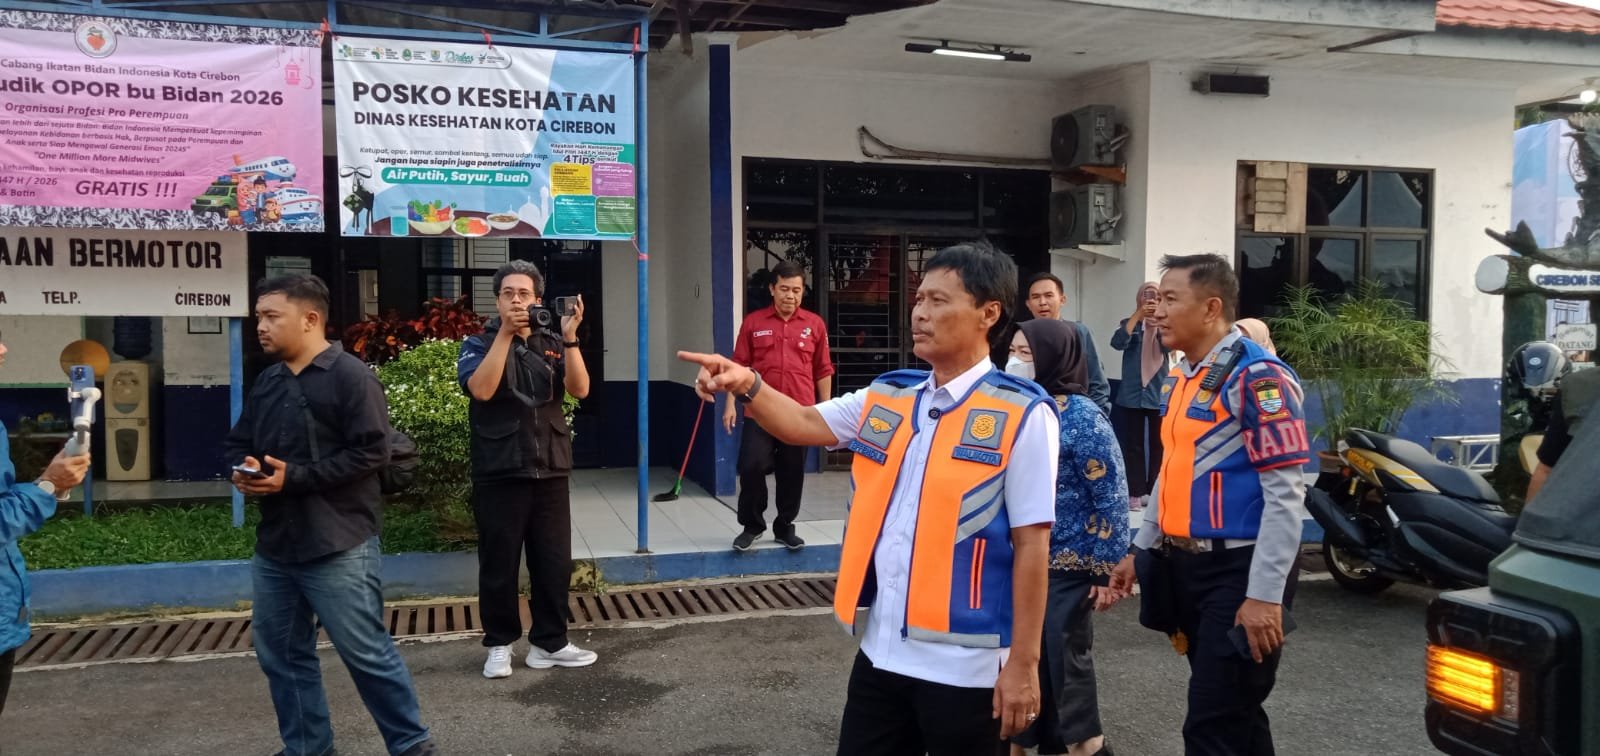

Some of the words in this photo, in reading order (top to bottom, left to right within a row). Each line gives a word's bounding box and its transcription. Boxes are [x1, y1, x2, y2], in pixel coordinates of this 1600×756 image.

[1, 59, 43, 72] Cabang
[46, 62, 81, 72] Ikatan
[85, 65, 115, 75] Bidan
[119, 66, 170, 77] Indonesia
[174, 70, 197, 80] Kota
[200, 71, 240, 81] Cirebon
[52, 80, 120, 98] OPOR
[128, 84, 155, 100] bu
[162, 86, 224, 103] Bidan
[230, 90, 284, 106] 2026
[353, 81, 451, 106] POSKO
[458, 88, 616, 114] KESEHATAN
[5, 102, 64, 114] Organisasi
[68, 106, 105, 117] Profesi
[108, 108, 126, 117] Pro
[130, 109, 189, 120] Perempuan
[163, 126, 209, 135] Memperkuat
[354, 112, 405, 127] DINAS
[408, 114, 502, 130] KESEHATAN
[505, 117, 548, 132] KOTA
[551, 120, 616, 135] CIREBON
[68, 142, 108, 150] Mengawal
[188, 137, 228, 145] Perempuan
[59, 153, 90, 161] Million
[93, 154, 117, 162] More
[375, 157, 408, 166] Jangan
[410, 158, 428, 166] lupa
[430, 158, 456, 167] siapin
[456, 158, 476, 168] juga
[477, 160, 541, 170] penetralisirnya
[34, 177, 58, 186] 2026
[387, 169, 408, 180] Air
[409, 170, 448, 182] Putih,
[451, 171, 493, 185] Sayur,
[495, 172, 528, 183] Buah
[76, 180, 149, 197] GRATIS
[156, 182, 177, 198] !!!
[70, 238, 223, 269] BERMOTOR
[1536, 274, 1588, 286] CIREBON
[42, 291, 81, 305] TELP.
[175, 292, 231, 306] CIREBON
